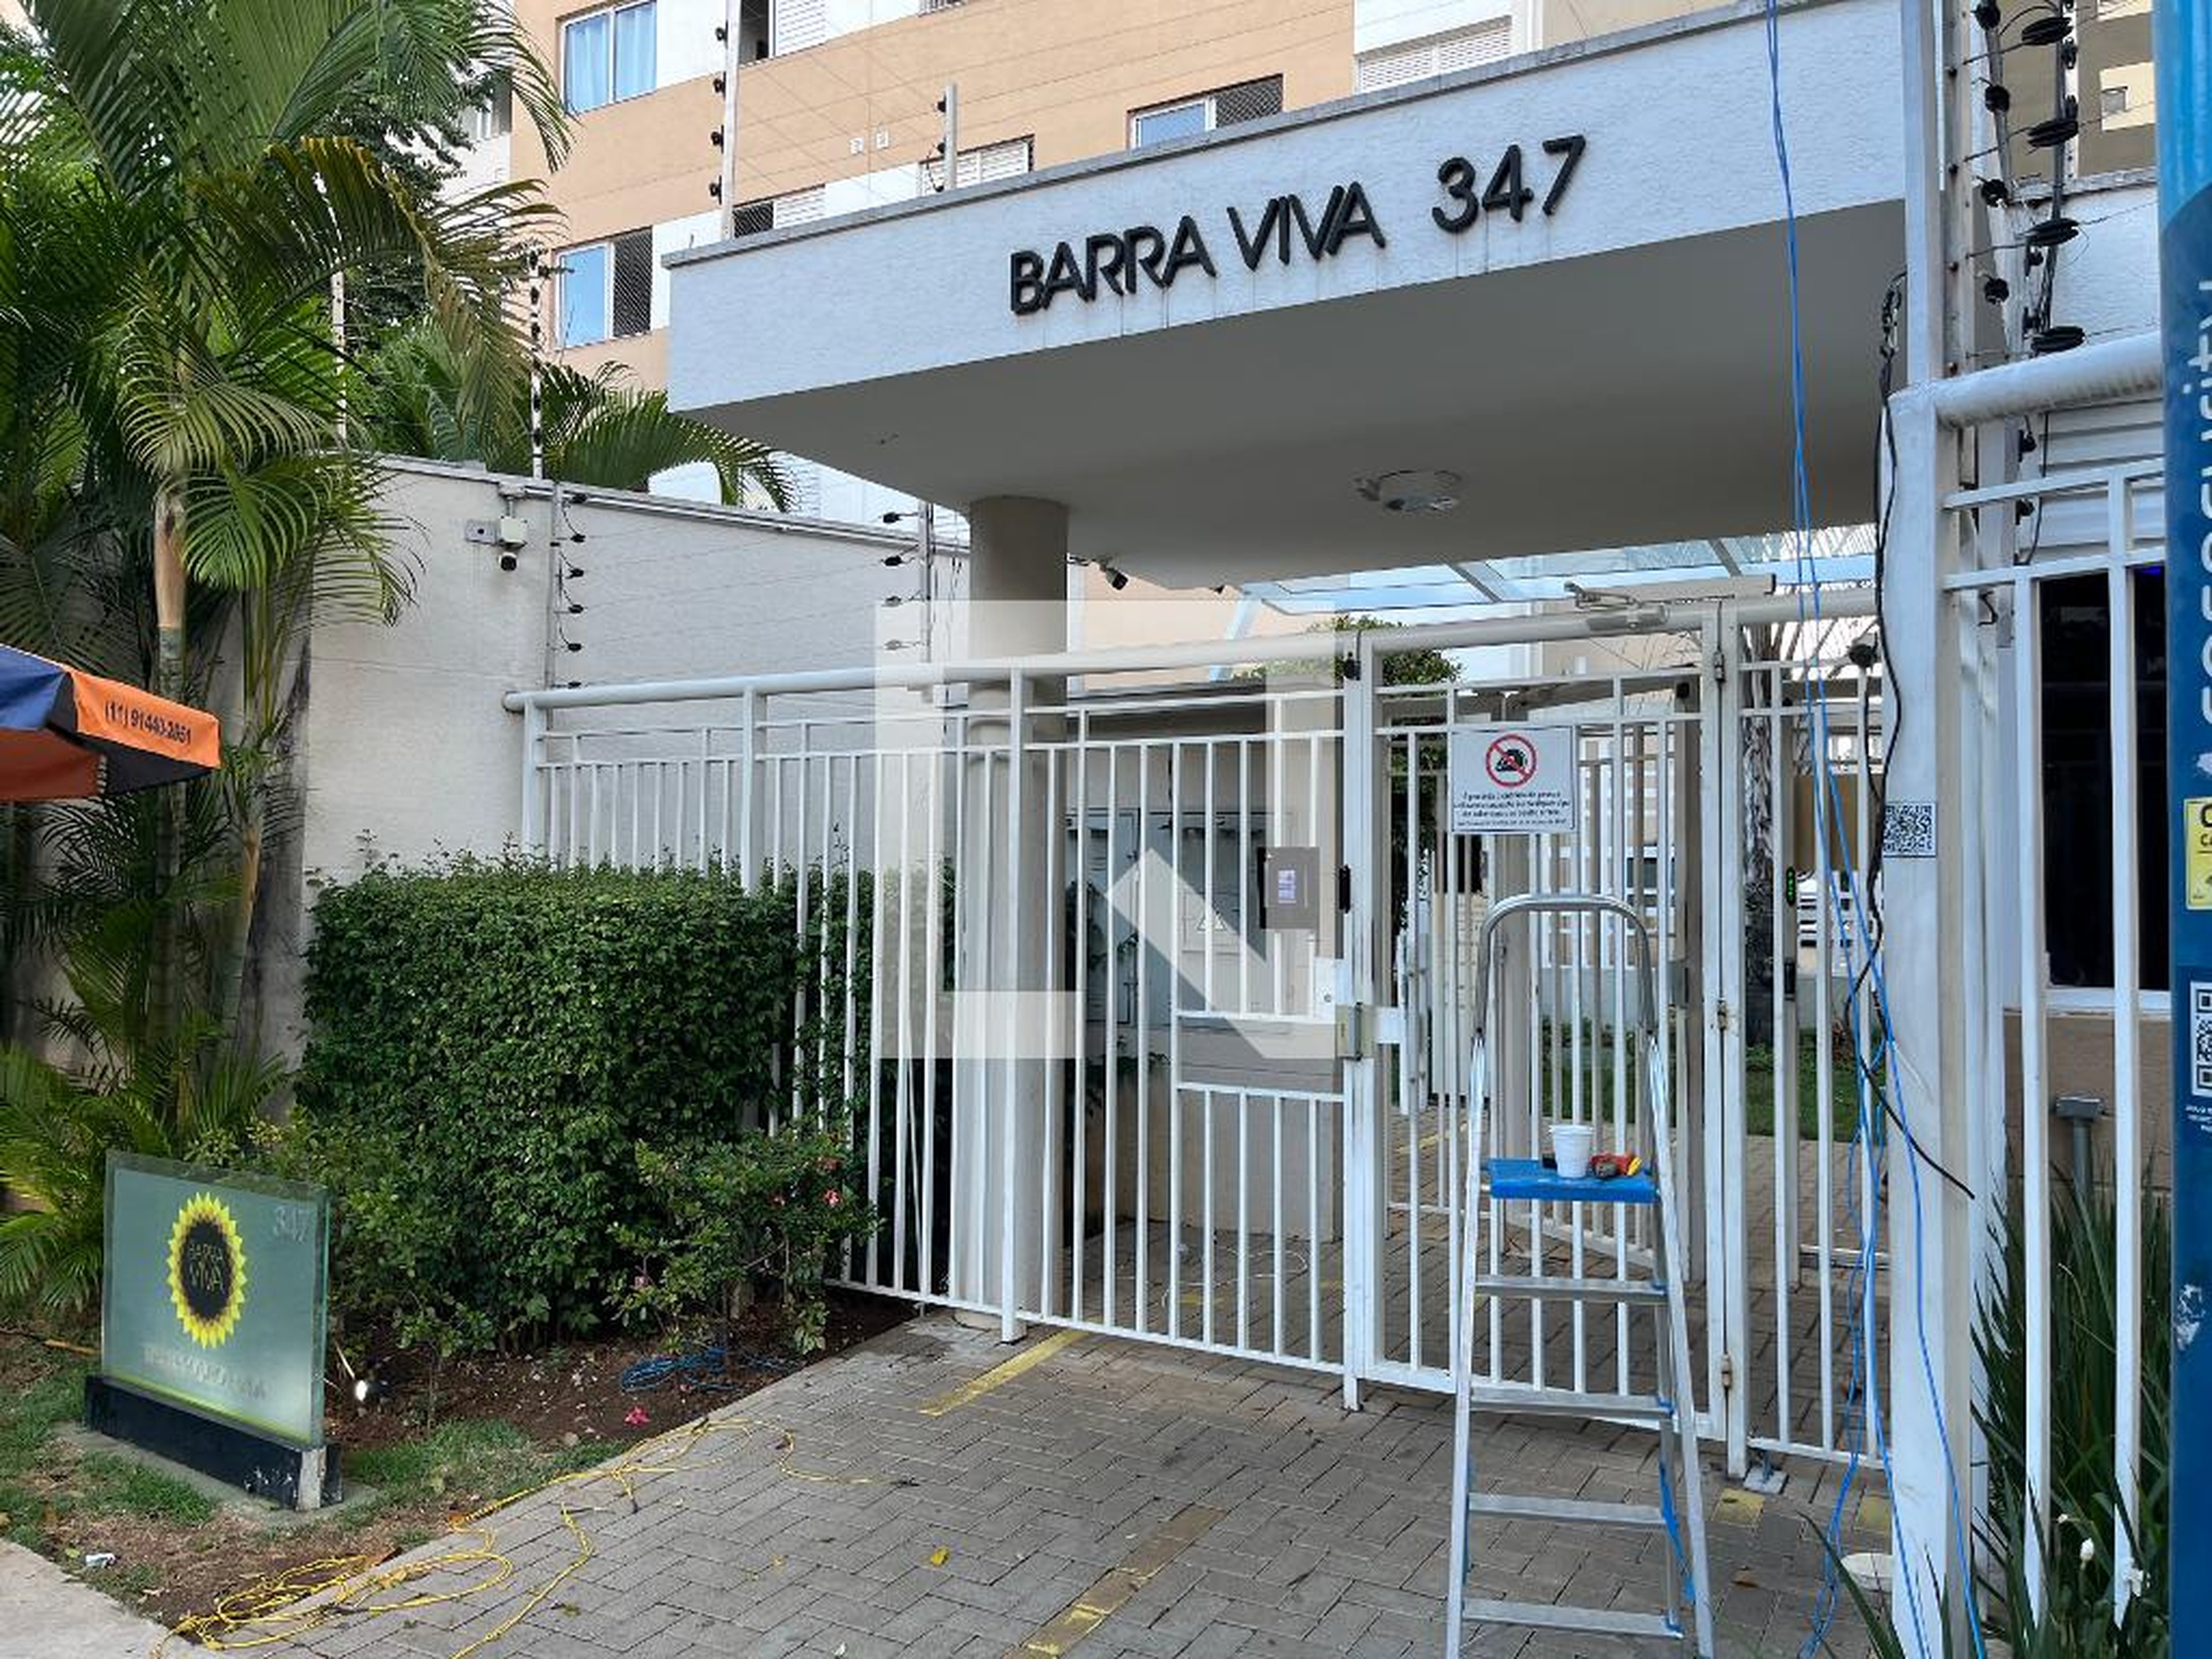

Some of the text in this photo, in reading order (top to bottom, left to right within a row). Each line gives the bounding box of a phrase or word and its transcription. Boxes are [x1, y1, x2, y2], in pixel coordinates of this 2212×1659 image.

[1010, 134, 1586, 315] BARRA VIVA 347
